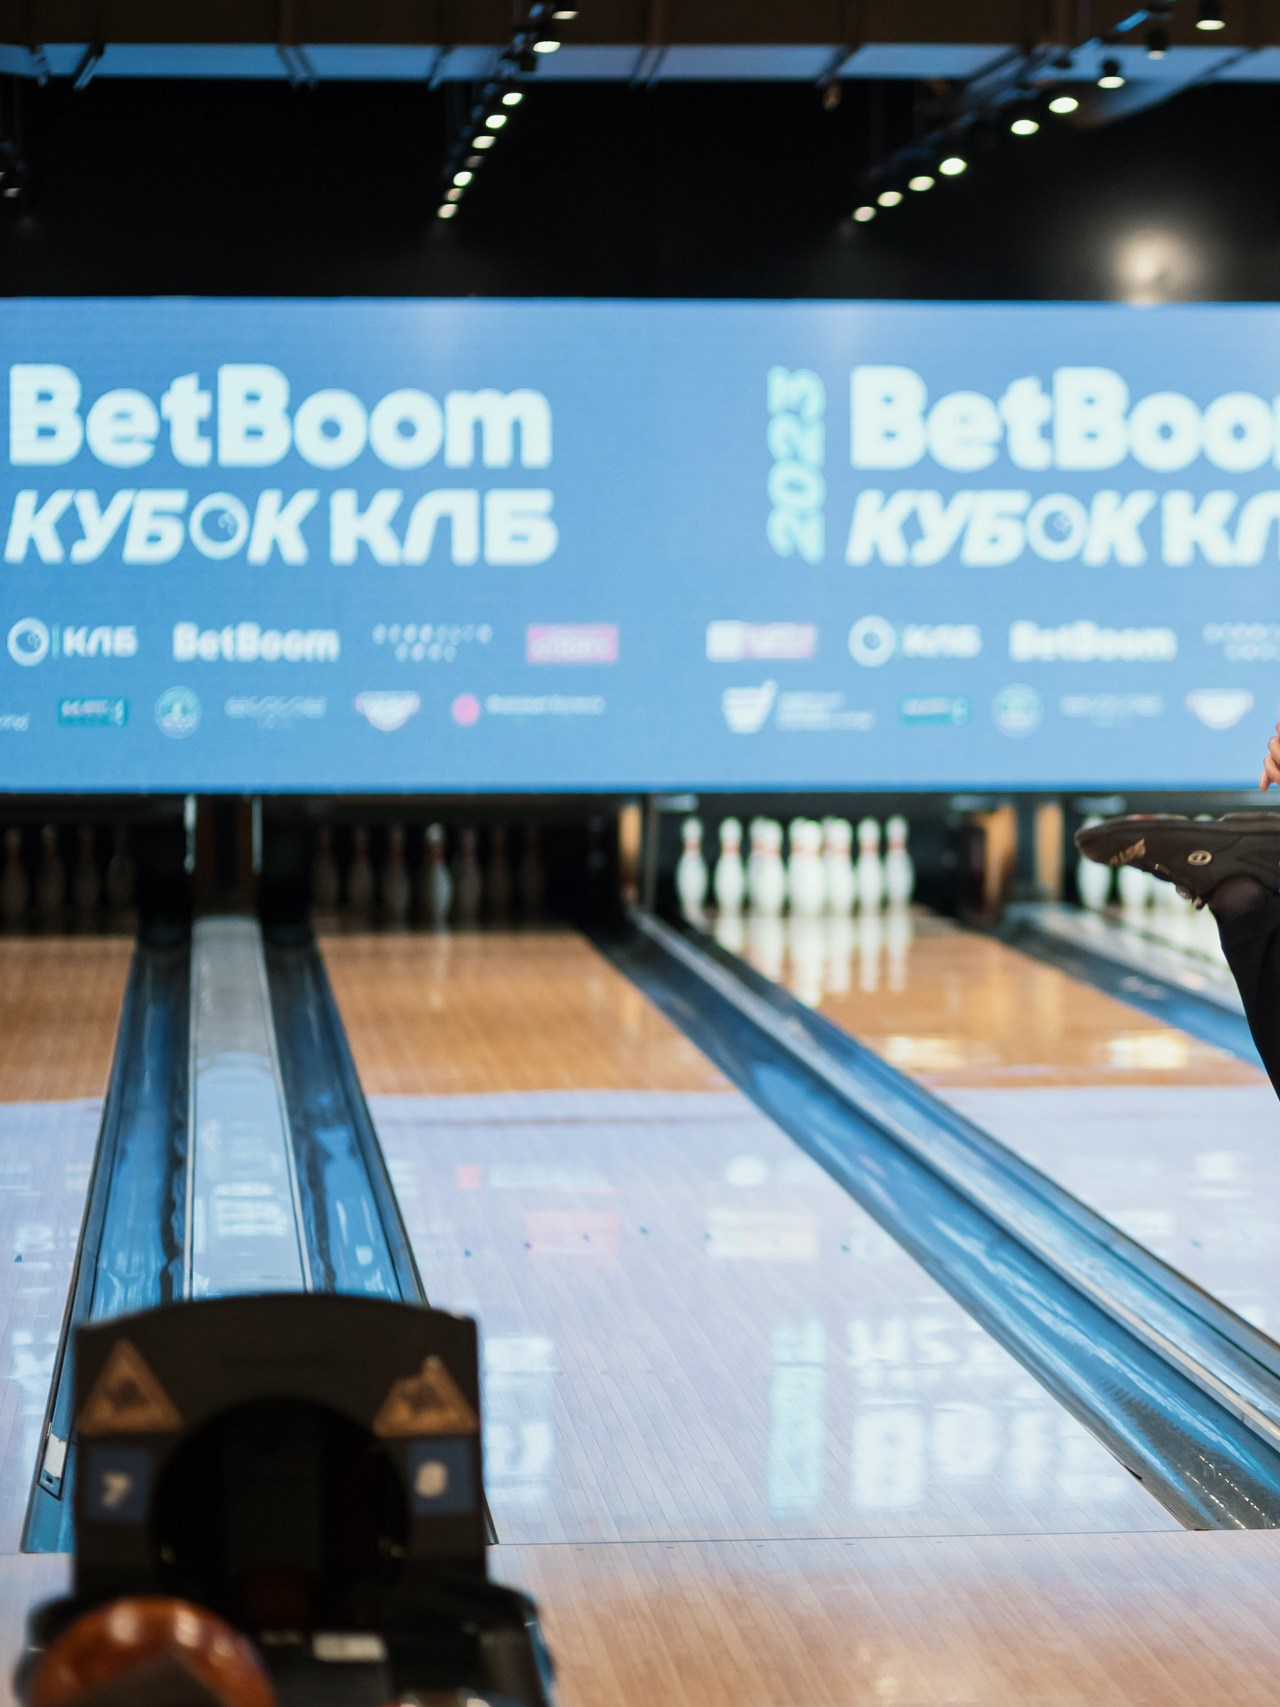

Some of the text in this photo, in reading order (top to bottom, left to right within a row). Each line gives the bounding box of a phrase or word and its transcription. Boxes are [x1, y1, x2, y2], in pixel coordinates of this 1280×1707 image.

[9, 363, 554, 469] BetBoom
[766, 365, 827, 565] 2023
[3, 488, 559, 567] КУБОК КЛБ
[845, 490, 1158, 567] КУБОК
[172, 621, 341, 662] BetBoom
[1008, 619, 1178, 663] BetBoom
